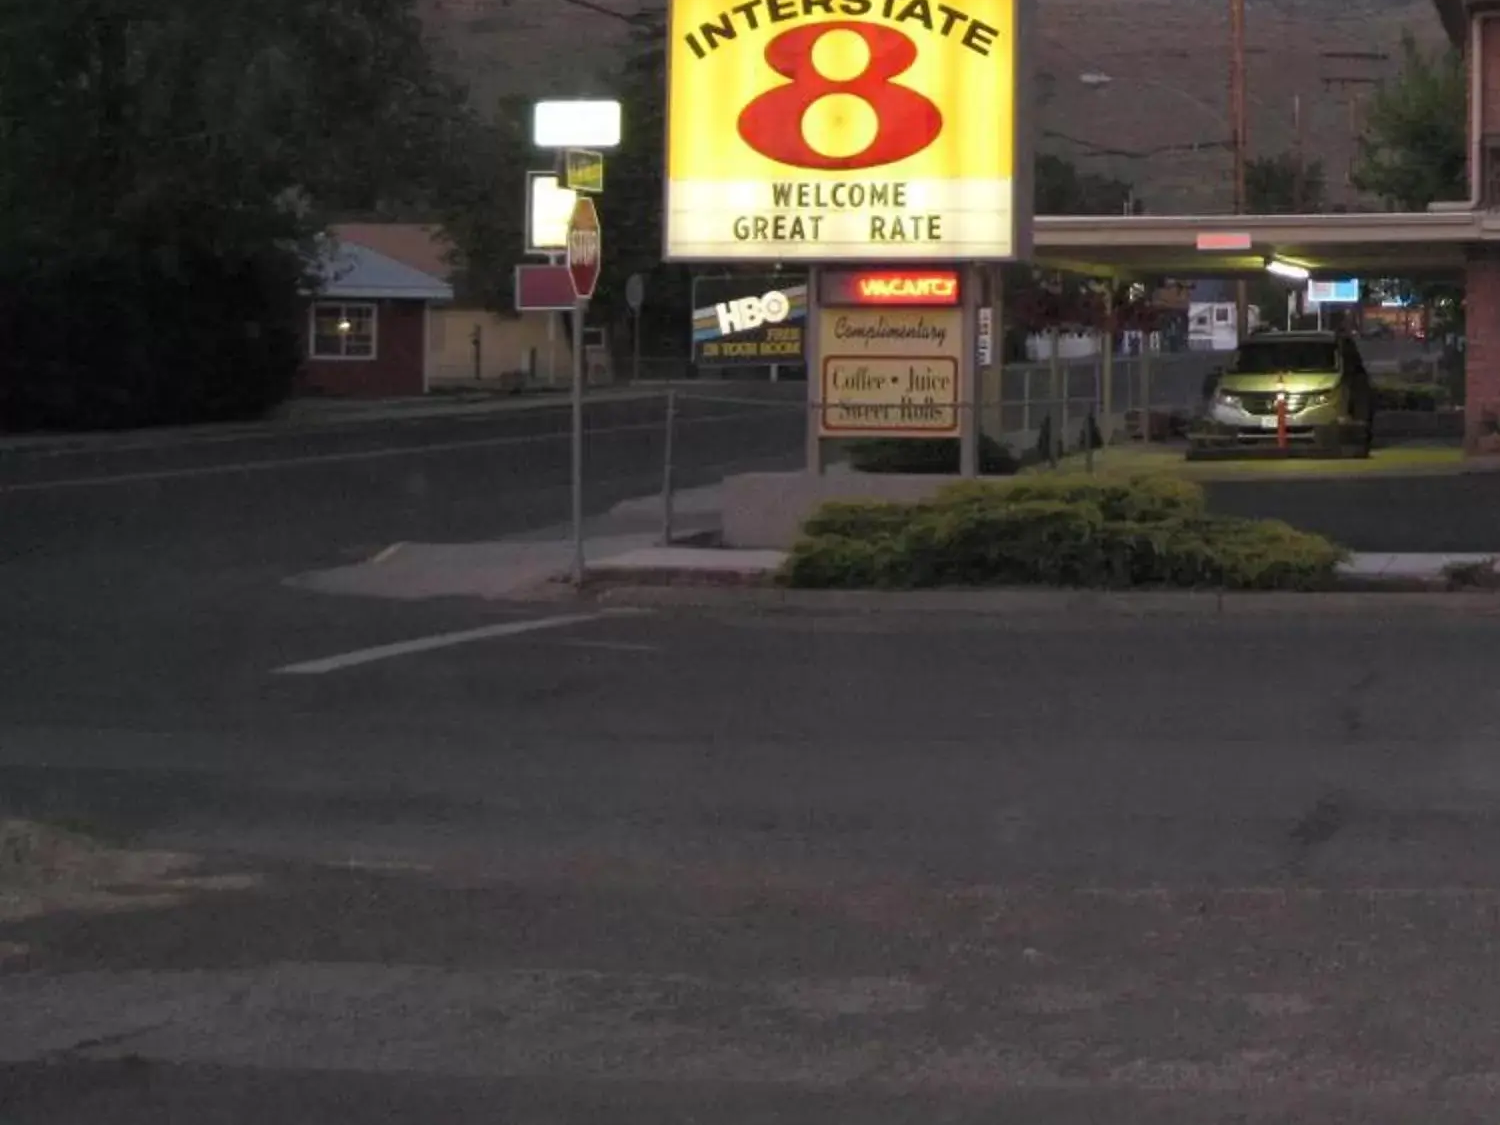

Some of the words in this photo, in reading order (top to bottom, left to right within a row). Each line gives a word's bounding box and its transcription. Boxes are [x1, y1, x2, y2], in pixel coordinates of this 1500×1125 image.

[737, 20, 942, 170] 8
[772, 182, 908, 208] WELCOME
[733, 216, 824, 241] GREAT
[870, 216, 942, 241] RATE
[859, 277, 957, 296] VACANCY
[716, 290, 790, 336] HBO
[833, 316, 947, 349] Complimentary
[832, 365, 886, 391] Coffee
[905, 366, 951, 393] Juice
